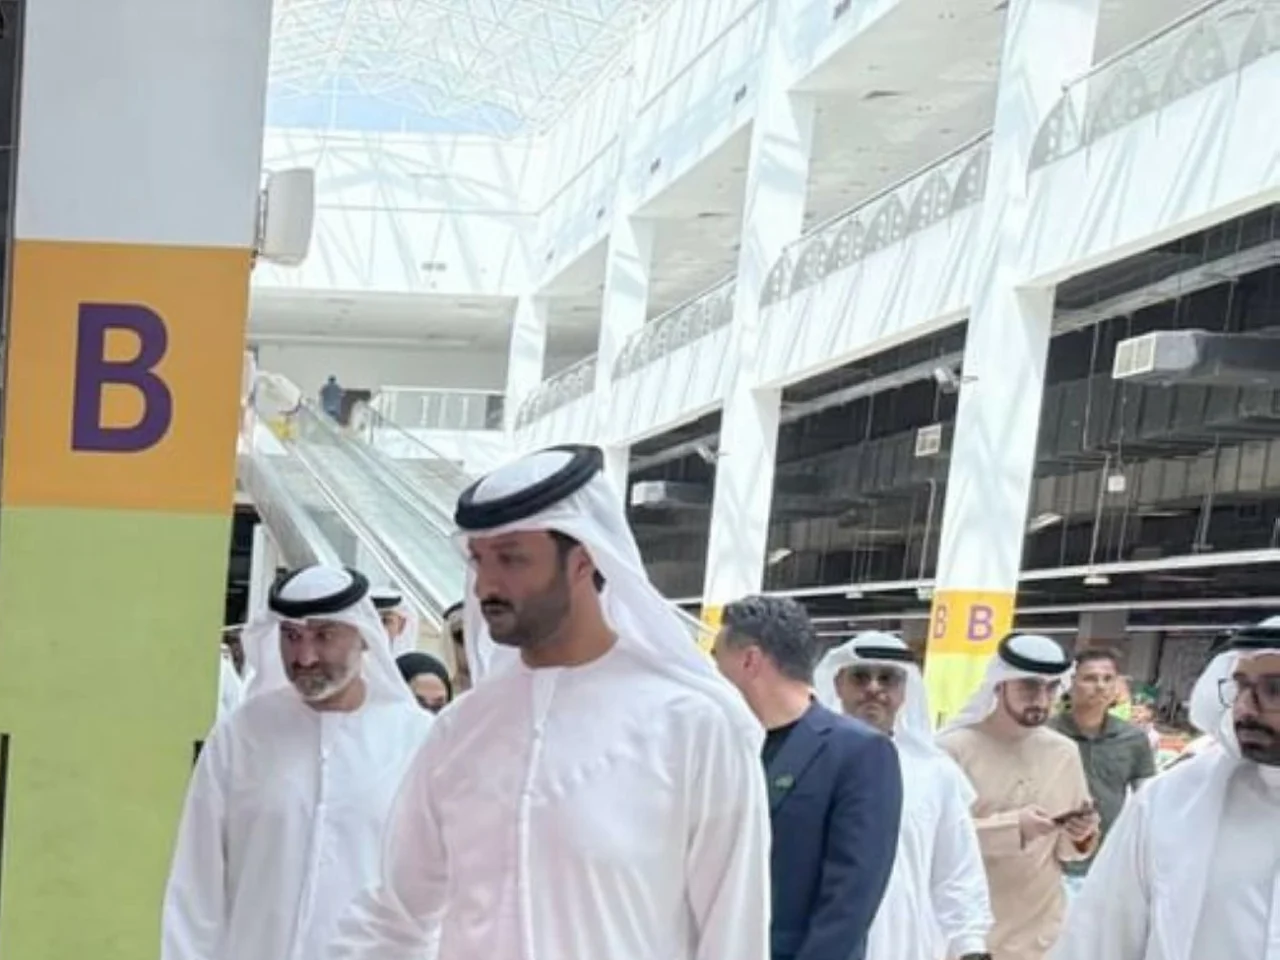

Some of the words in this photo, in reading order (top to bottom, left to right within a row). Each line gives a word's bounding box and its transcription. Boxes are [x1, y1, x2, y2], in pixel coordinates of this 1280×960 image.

[72, 303, 173, 453] B
[933, 605, 947, 639] B
[967, 604, 993, 641] B
